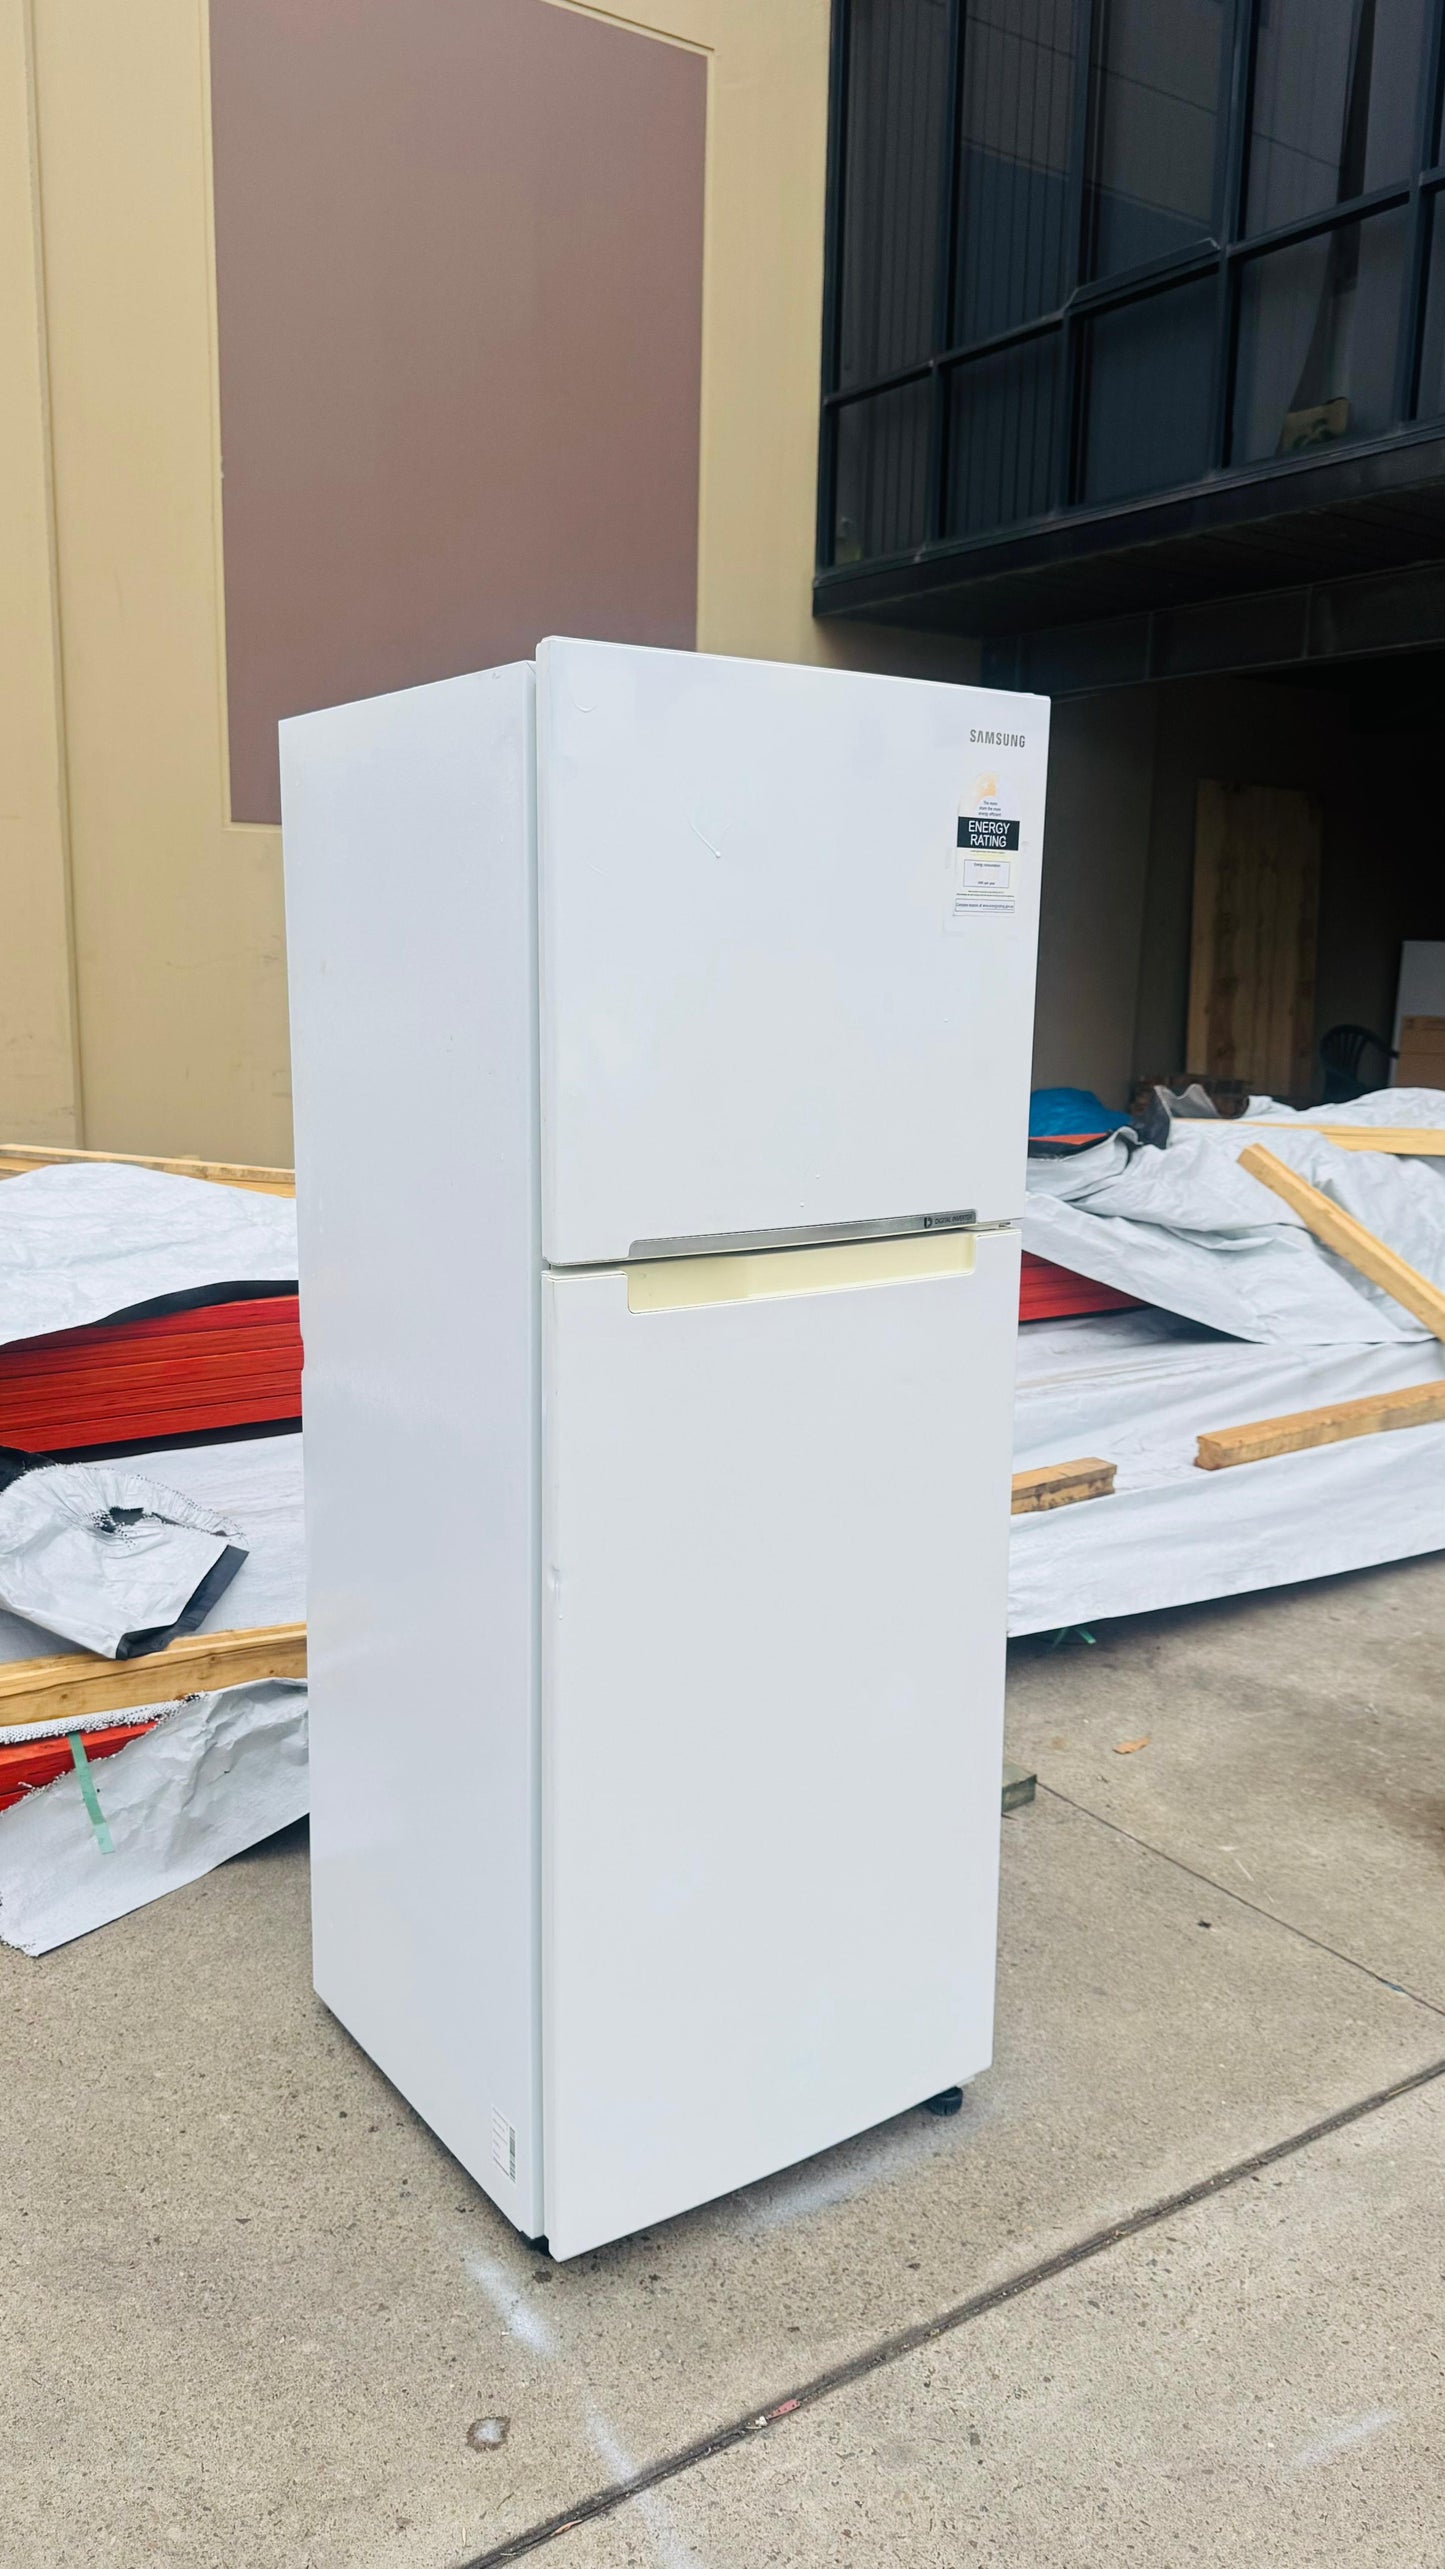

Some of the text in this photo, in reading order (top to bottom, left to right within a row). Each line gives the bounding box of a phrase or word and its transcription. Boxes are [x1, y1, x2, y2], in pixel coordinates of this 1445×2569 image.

[969, 729, 1026, 748] SAMSUNG
[968, 820, 1010, 835] ENERGY
[970, 833, 1007, 848] RATING
